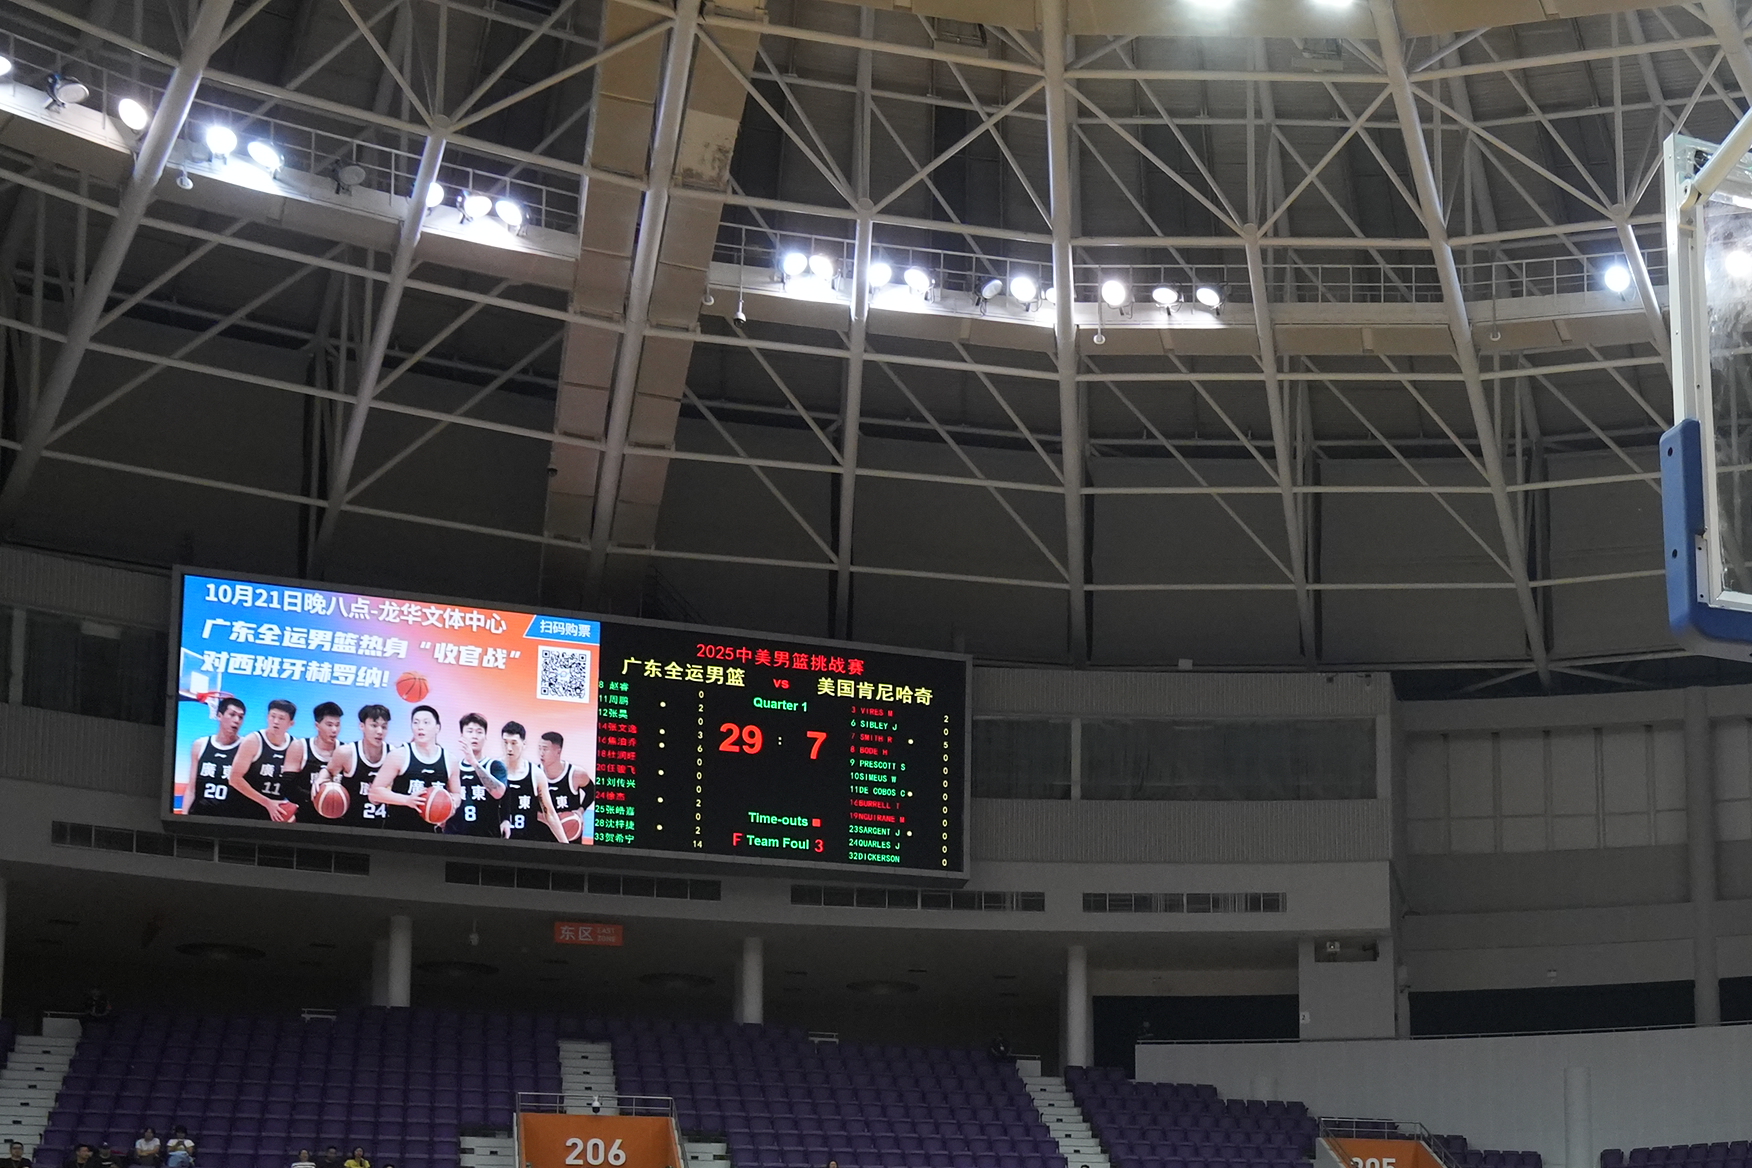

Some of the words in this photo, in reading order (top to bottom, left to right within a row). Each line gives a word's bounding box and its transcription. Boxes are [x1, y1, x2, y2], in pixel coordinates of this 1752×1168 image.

[205, 583, 507, 634] 10月21日晚八点-龙华文体中心
[539, 620, 591, 638] 扫码购票
[696, 644, 865, 676] 2025中美男篮挑战赛
[622, 656, 746, 688] 广东全运男篮
[817, 677, 934, 706] 美国肯尼哈奇
[698, 690, 704, 698] 0
[698, 704, 704, 712] 2
[753, 697, 798, 712] Quarter
[801, 702, 808, 712] 1
[698, 717, 704, 726] 0
[860, 708, 884, 716] VIRES
[944, 715, 950, 723] 2
[697, 730, 704, 739] 3
[850, 719, 856, 727] 6
[860, 720, 888, 730] SIBLEY
[943, 728, 950, 736] 0
[718, 722, 764, 754] 29
[806, 730, 828, 760] 7
[860, 734, 884, 742] SMITH
[943, 740, 949, 749] 5
[696, 744, 704, 753] 6
[850, 746, 856, 754] 8
[942, 753, 949, 762] 0
[696, 758, 703, 766] 0
[850, 758, 856, 766] 9
[860, 760, 896, 770] PRESCOTT
[942, 766, 949, 775] 0
[696, 771, 702, 780] 0
[262, 782, 281, 796] 11
[696, 785, 702, 794] 0
[942, 780, 948, 788] 0
[204, 783, 228, 800] 20
[873, 787, 896, 797] COBOS
[942, 792, 948, 801] 0
[696, 798, 702, 808] 2
[942, 806, 948, 814] 0
[362, 804, 386, 819] 24
[464, 806, 477, 822] 8
[695, 812, 702, 821] 0
[748, 812, 808, 827] Time-outs
[942, 818, 948, 828] 0
[695, 826, 702, 835] 2
[942, 832, 948, 840] 0
[692, 840, 703, 848] 14
[732, 832, 744, 846] F
[746, 834, 780, 848] Team
[782, 838, 810, 850] Foul
[814, 838, 824, 853] 3
[941, 845, 948, 854] 0
[941, 858, 948, 867] 0
[560, 926, 594, 942] 东区
[565, 1138, 626, 1166] 206
